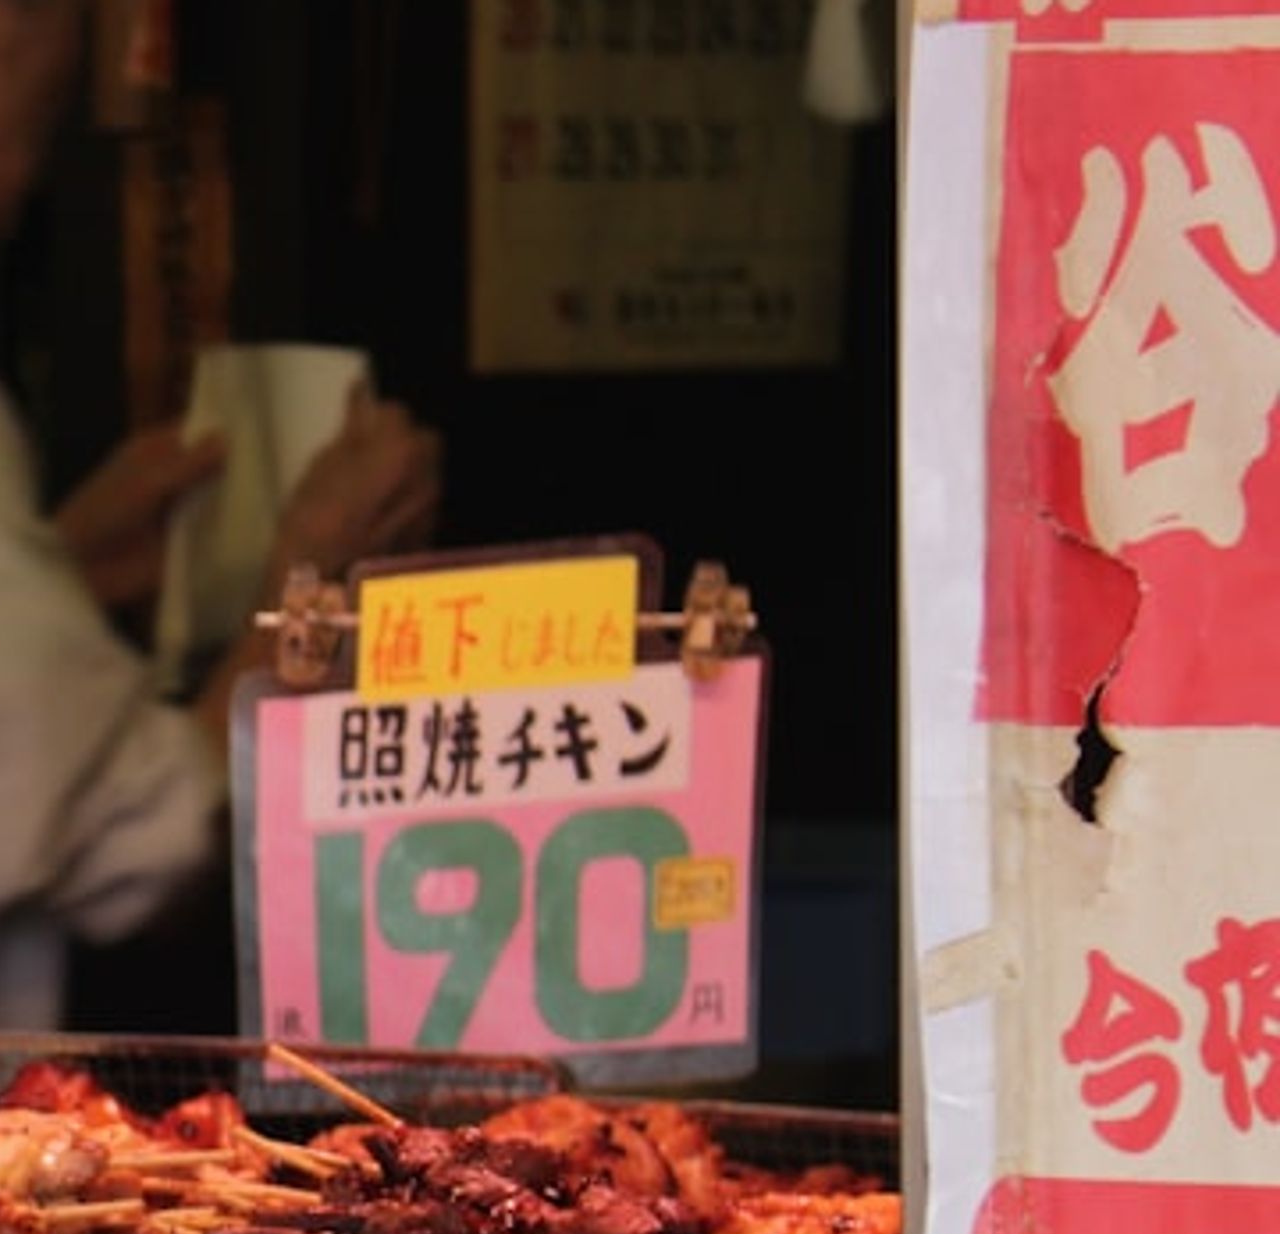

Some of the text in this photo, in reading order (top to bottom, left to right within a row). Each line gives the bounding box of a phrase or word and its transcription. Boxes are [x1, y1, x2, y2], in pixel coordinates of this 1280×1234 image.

[338, 695, 671, 809] 照焼チキン
[314, 805, 692, 1052] 190
